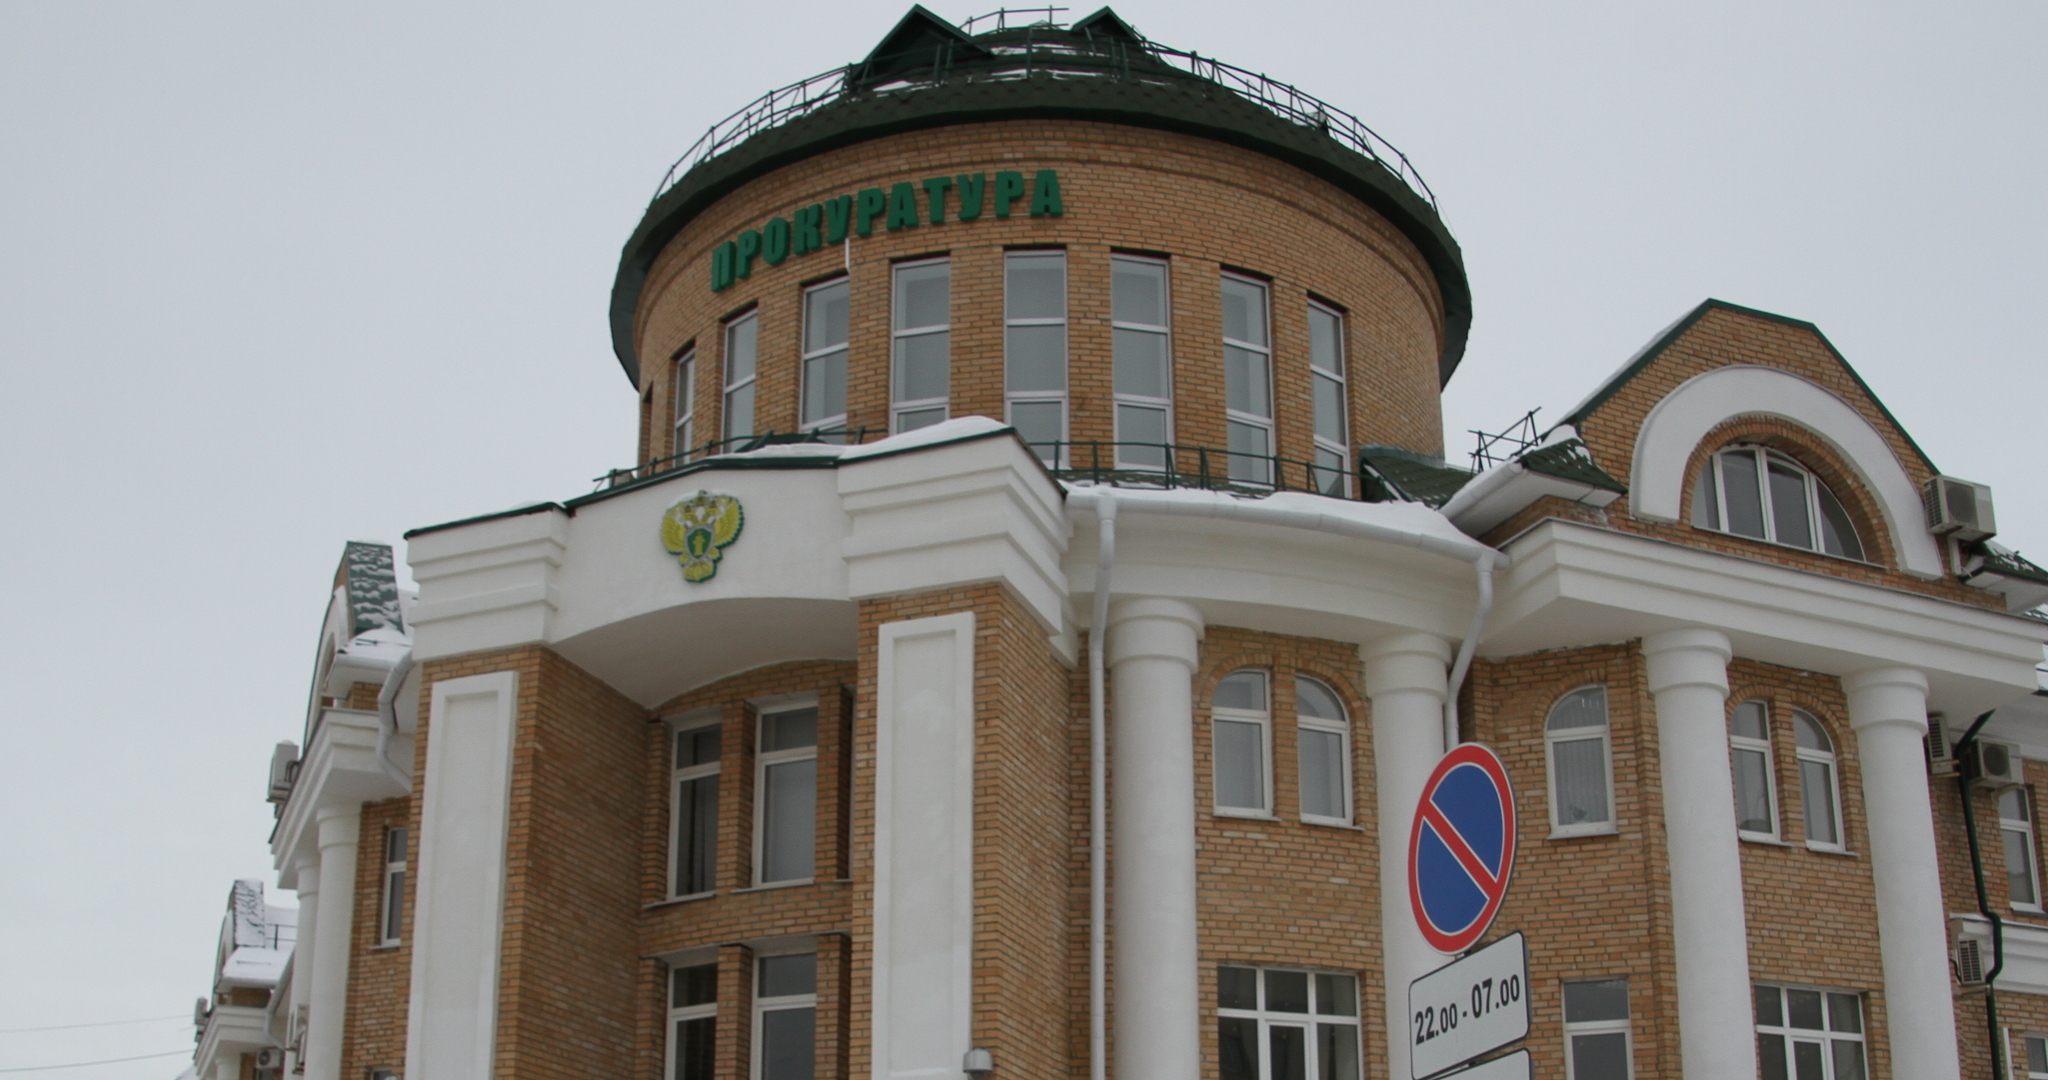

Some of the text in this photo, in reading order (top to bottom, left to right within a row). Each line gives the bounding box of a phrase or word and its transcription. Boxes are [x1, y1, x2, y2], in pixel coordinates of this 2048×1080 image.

[711, 169, 1063, 292] ПРОКУРАТУРА
[1415, 1002, 1458, 1045] 22.00
[1471, 974, 1520, 1019] 07.00
